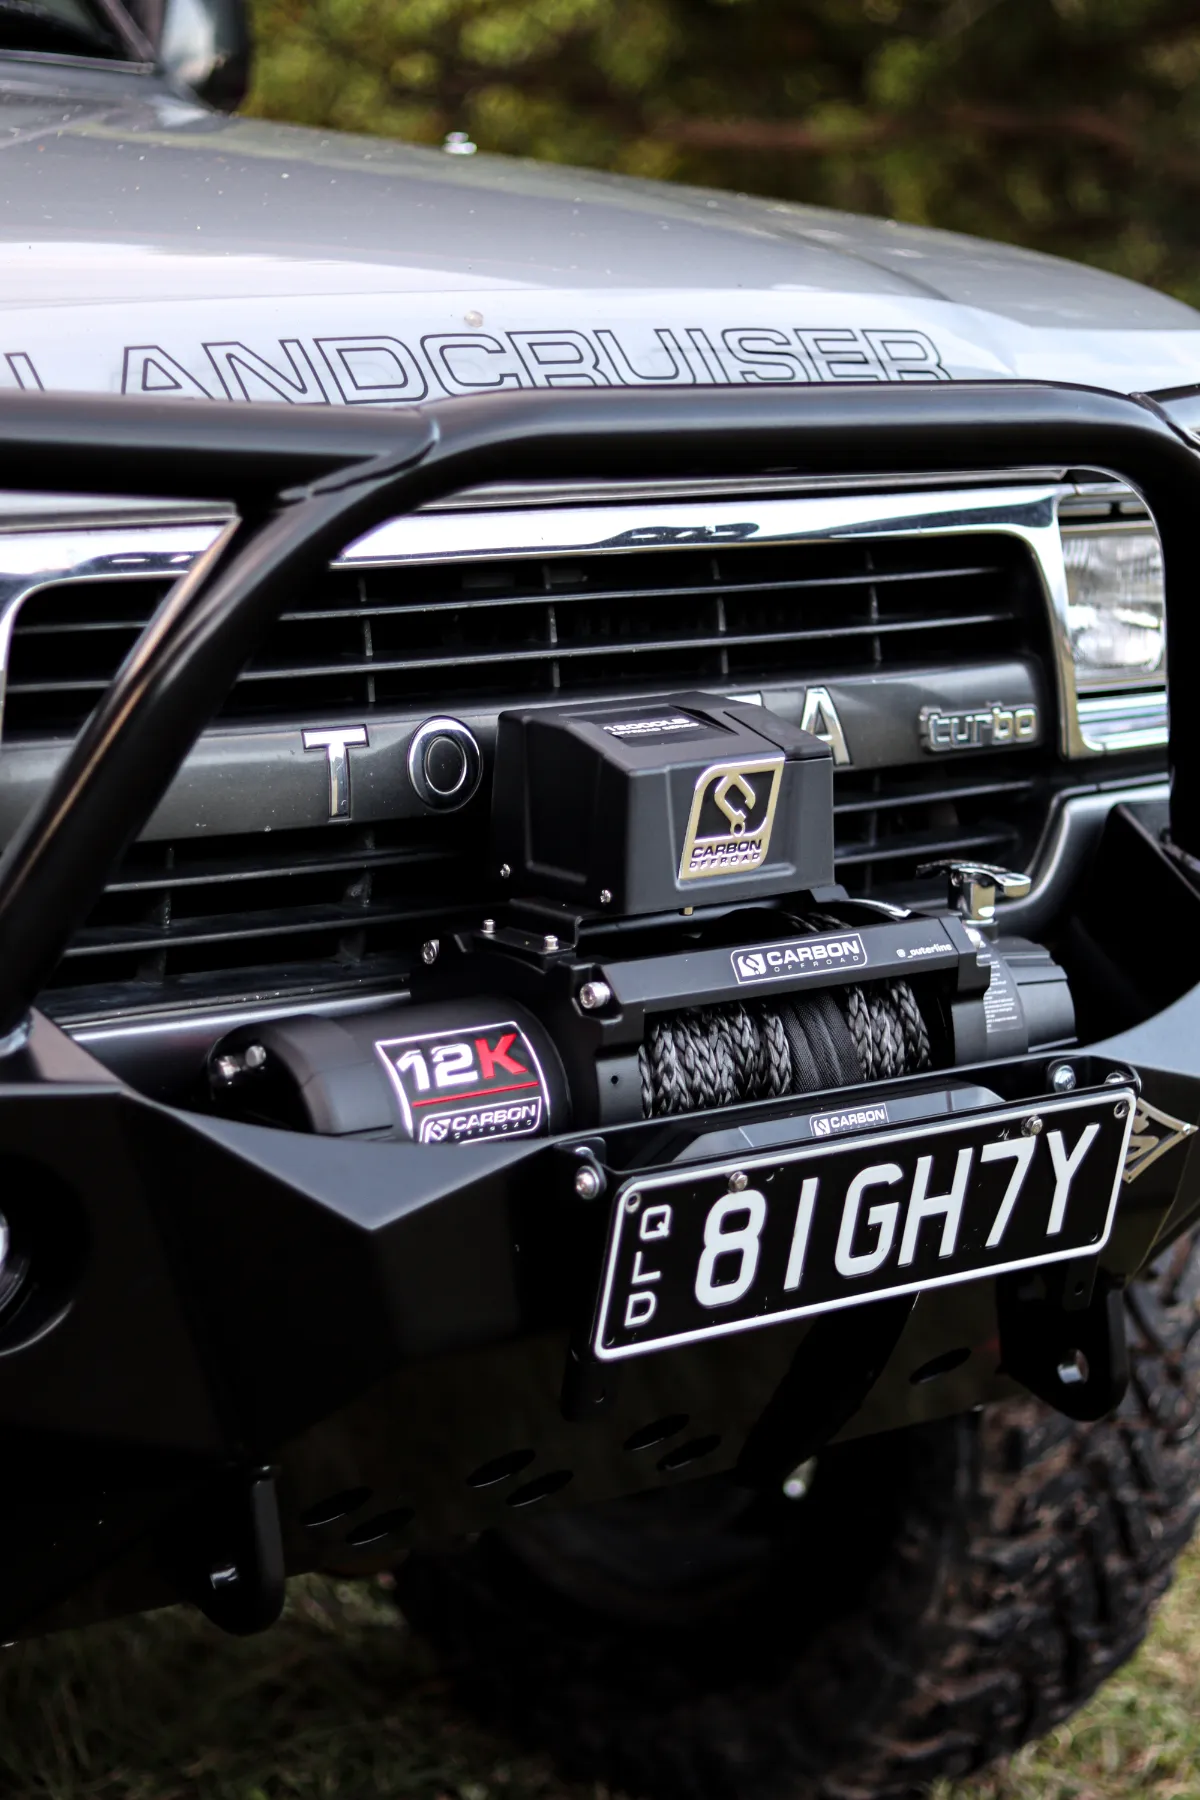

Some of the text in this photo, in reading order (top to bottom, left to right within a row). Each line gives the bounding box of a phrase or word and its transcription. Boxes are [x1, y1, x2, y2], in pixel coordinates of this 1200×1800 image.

[921, 702, 1037, 751] turbo
[689, 852, 760, 870] OFFROAD
[691, 839, 763, 859] CARBON
[766, 939, 860, 966] CARBON
[773, 954, 860, 973] OFFROAD
[396, 1033, 529, 1092] 12K
[452, 1104, 537, 1131] CARBON
[830, 1108, 886, 1129] CARBON
